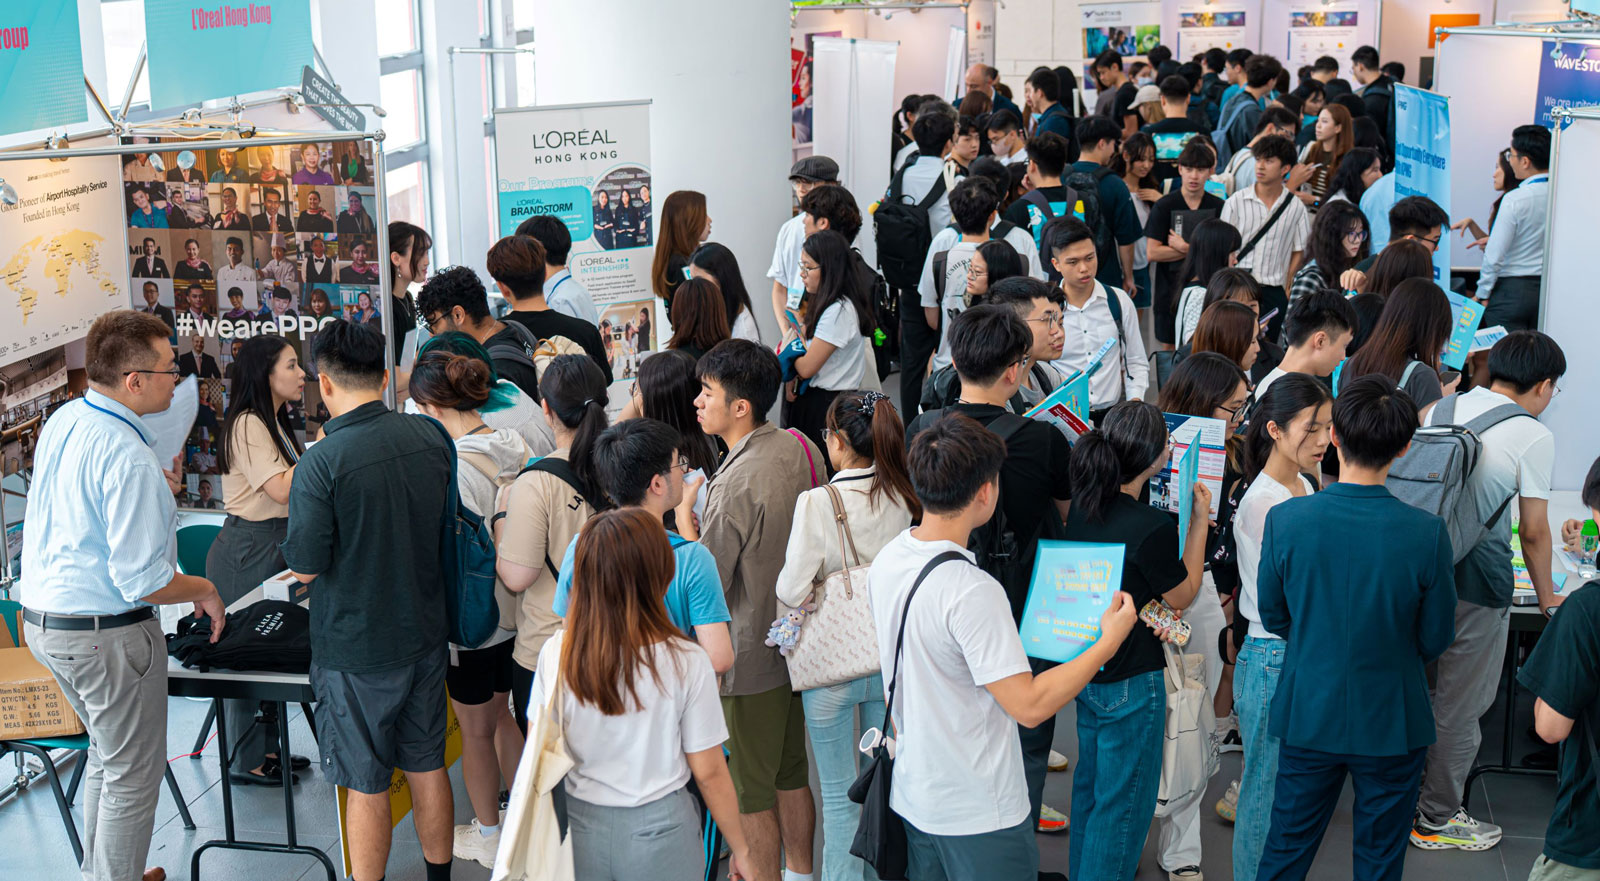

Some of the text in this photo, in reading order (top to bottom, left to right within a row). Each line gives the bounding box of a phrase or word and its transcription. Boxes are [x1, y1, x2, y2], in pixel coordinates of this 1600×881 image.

[191, 3, 271, 31] L'Oreal Hong Kong
[312, 78, 331, 99] CREATE
[305, 86, 319, 103] THAT
[335, 111, 346, 127] THE
[1544, 96, 1556, 107] We
[1557, 98, 1571, 107] are
[533, 129, 617, 149] L'ORÉAL
[535, 151, 618, 165] HONG KONG
[1422, 149, 1446, 170] Everywhere
[499, 176, 594, 192] Our Programs
[19, 196, 39, 209] Pioneer
[40, 195, 47, 204] of
[46, 190, 64, 202] Airport
[64, 185, 89, 197] Hospitality
[89, 180, 108, 192] Service
[22, 202, 80, 223] Founded in Hong Kong
[511, 202, 573, 216] BRANDSTORM
[581, 264, 629, 273] INTERNSHIPS
[255, 614, 273, 632] PLAZA
[261, 611, 284, 636] PREMIUM
